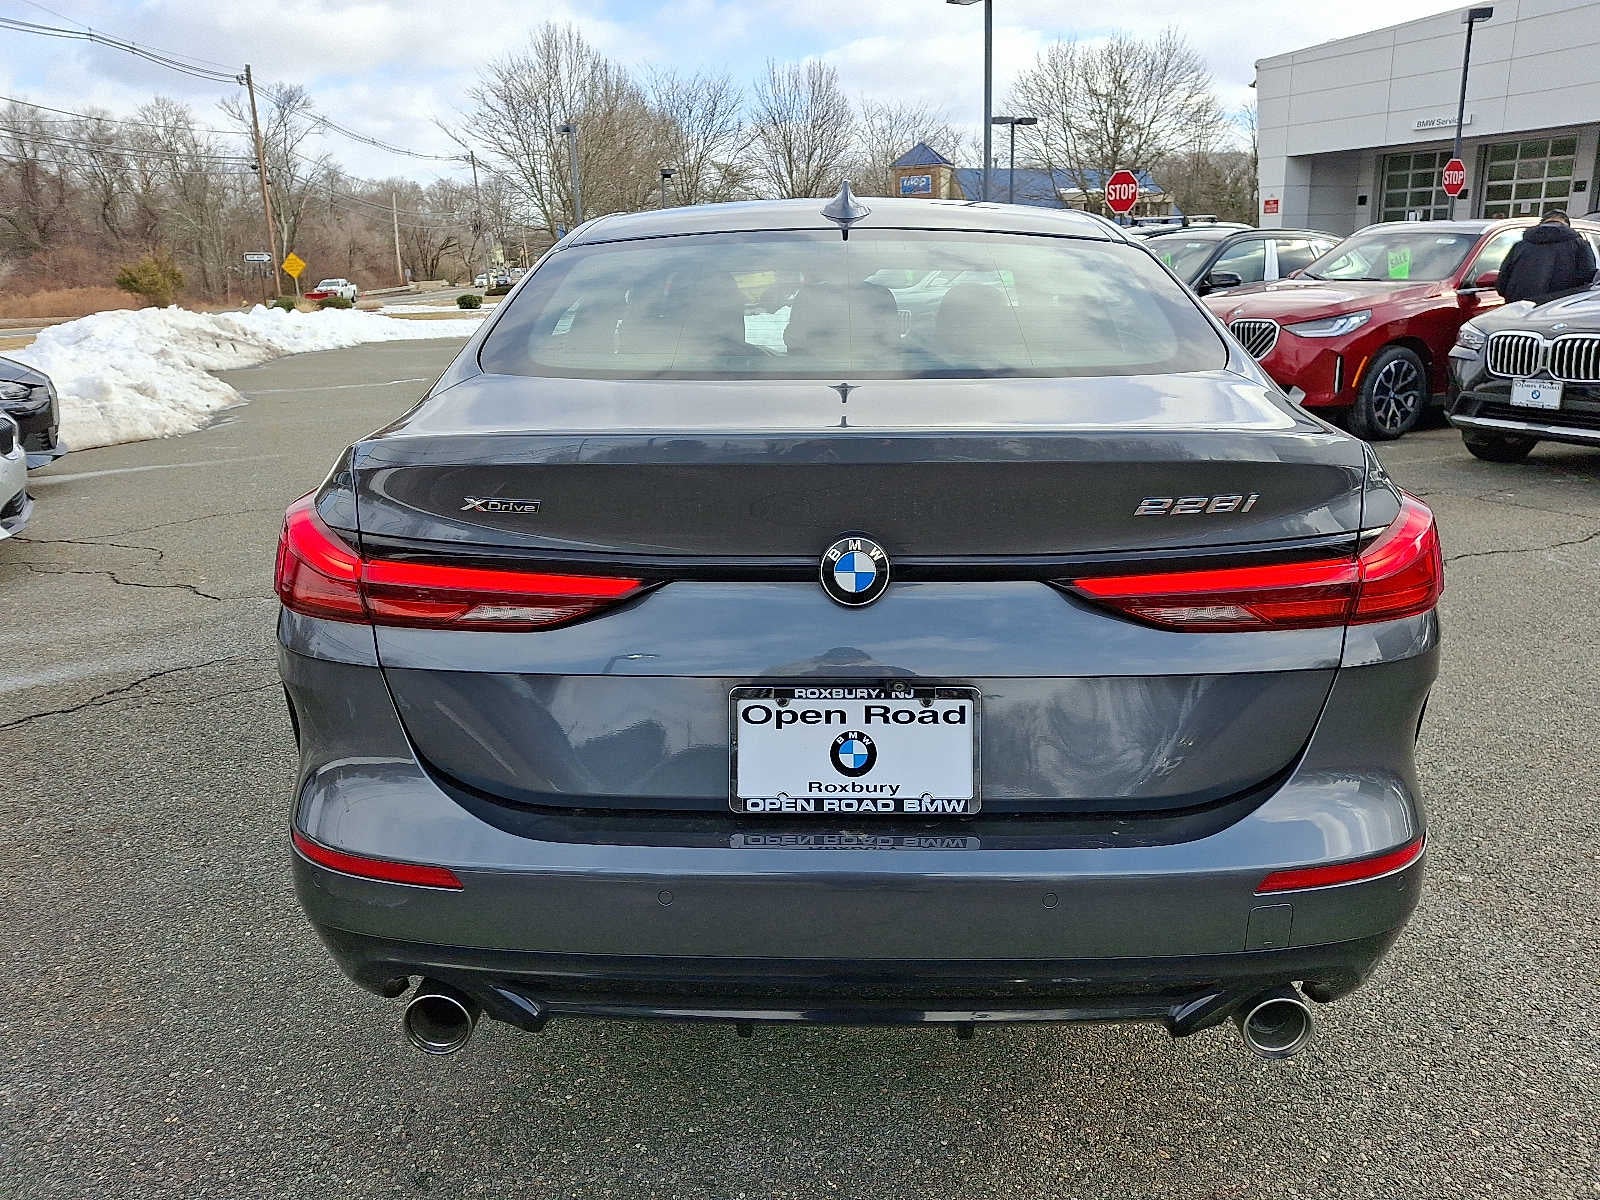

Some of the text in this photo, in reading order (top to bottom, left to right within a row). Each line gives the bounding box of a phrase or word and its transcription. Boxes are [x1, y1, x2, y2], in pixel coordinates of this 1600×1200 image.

[1416, 119, 1435, 128] BMW
[1444, 170, 1464, 185] STOP
[1107, 183, 1136, 201] STOP
[1134, 493, 1260, 517] 228i
[827, 539, 884, 562] BMW
[794, 688, 915, 699] ROXBURY, NJ
[741, 704, 966, 730] Open Road
[835, 731, 873, 746] BMW
[808, 781, 901, 797] Roxbury
[746, 799, 966, 812] OPEN ROAD BMW
